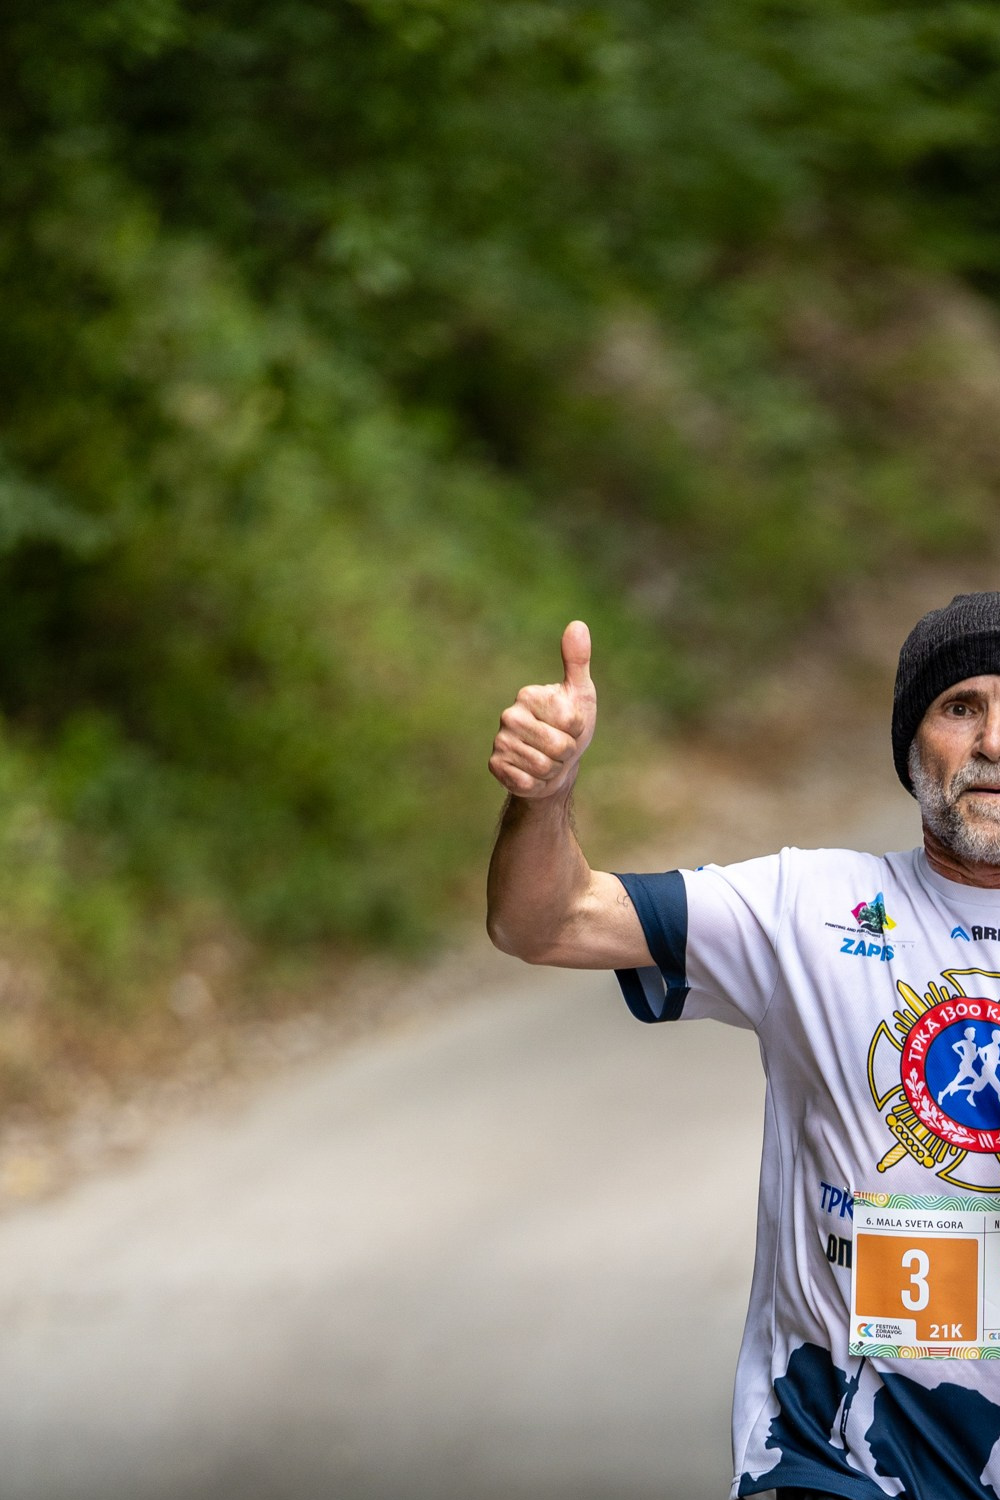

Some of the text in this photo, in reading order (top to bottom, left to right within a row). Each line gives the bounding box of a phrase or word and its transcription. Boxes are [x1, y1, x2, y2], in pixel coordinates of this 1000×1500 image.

[840, 937, 895, 961] ZAPIS
[908, 1018, 940, 1062] ТРКА
[939, 1003, 982, 1022] 1300
[866, 1217, 964, 1229] 6. MALA SVETA GORA
[901, 1248, 930, 1311] 3
[929, 1324, 963, 1338] 21K
